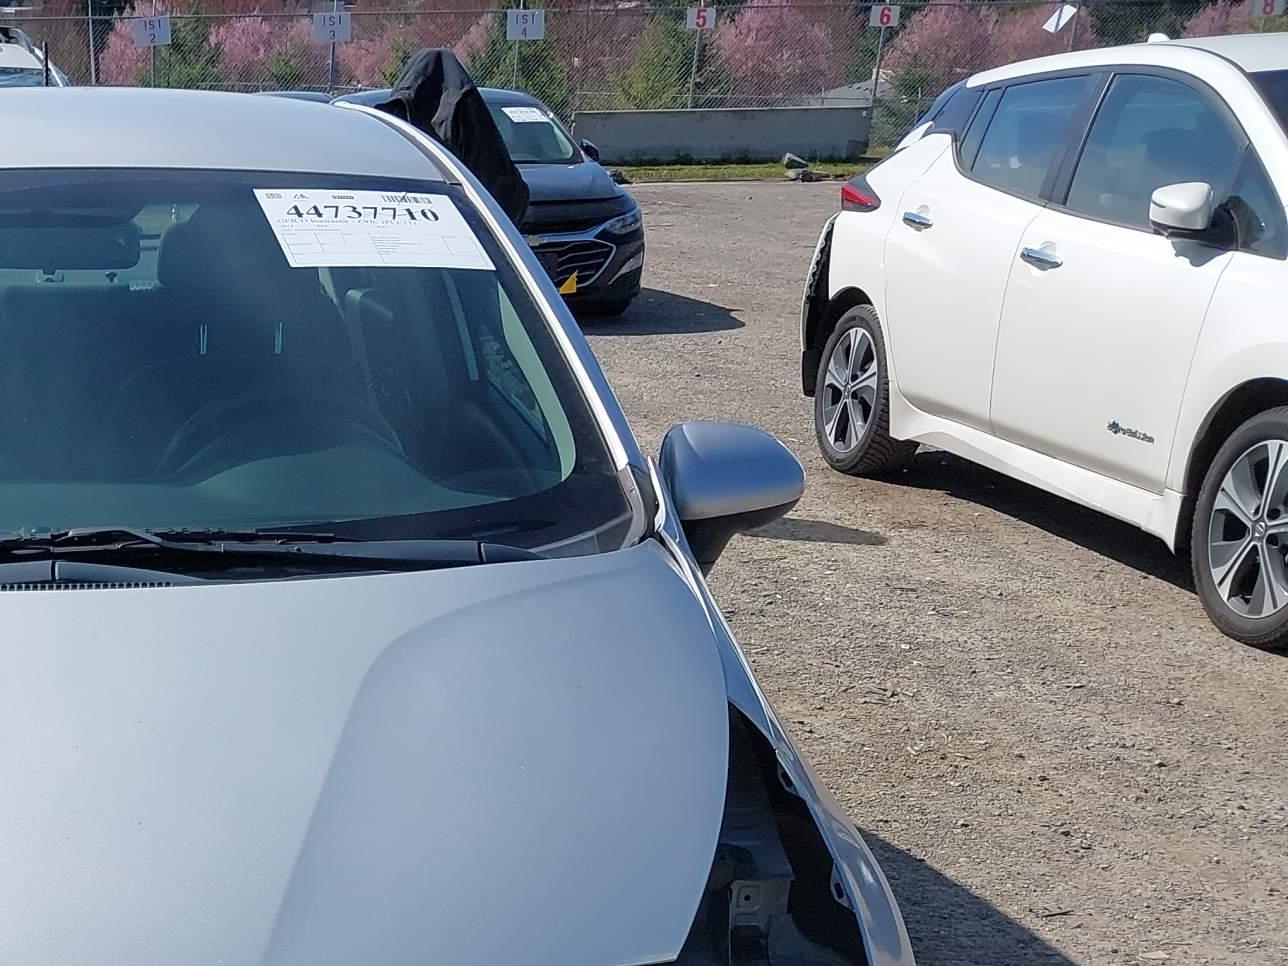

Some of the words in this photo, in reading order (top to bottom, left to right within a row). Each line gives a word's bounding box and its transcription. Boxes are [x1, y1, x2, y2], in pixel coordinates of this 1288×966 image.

[1263, 0, 1274, 15] 8
[695, 8, 707, 28] 5
[879, 6, 891, 26] 6
[149, 33, 156, 43] 2
[329, 29, 336, 40] 3
[521, 27, 527, 38] 4
[286, 204, 440, 222] 44737710
